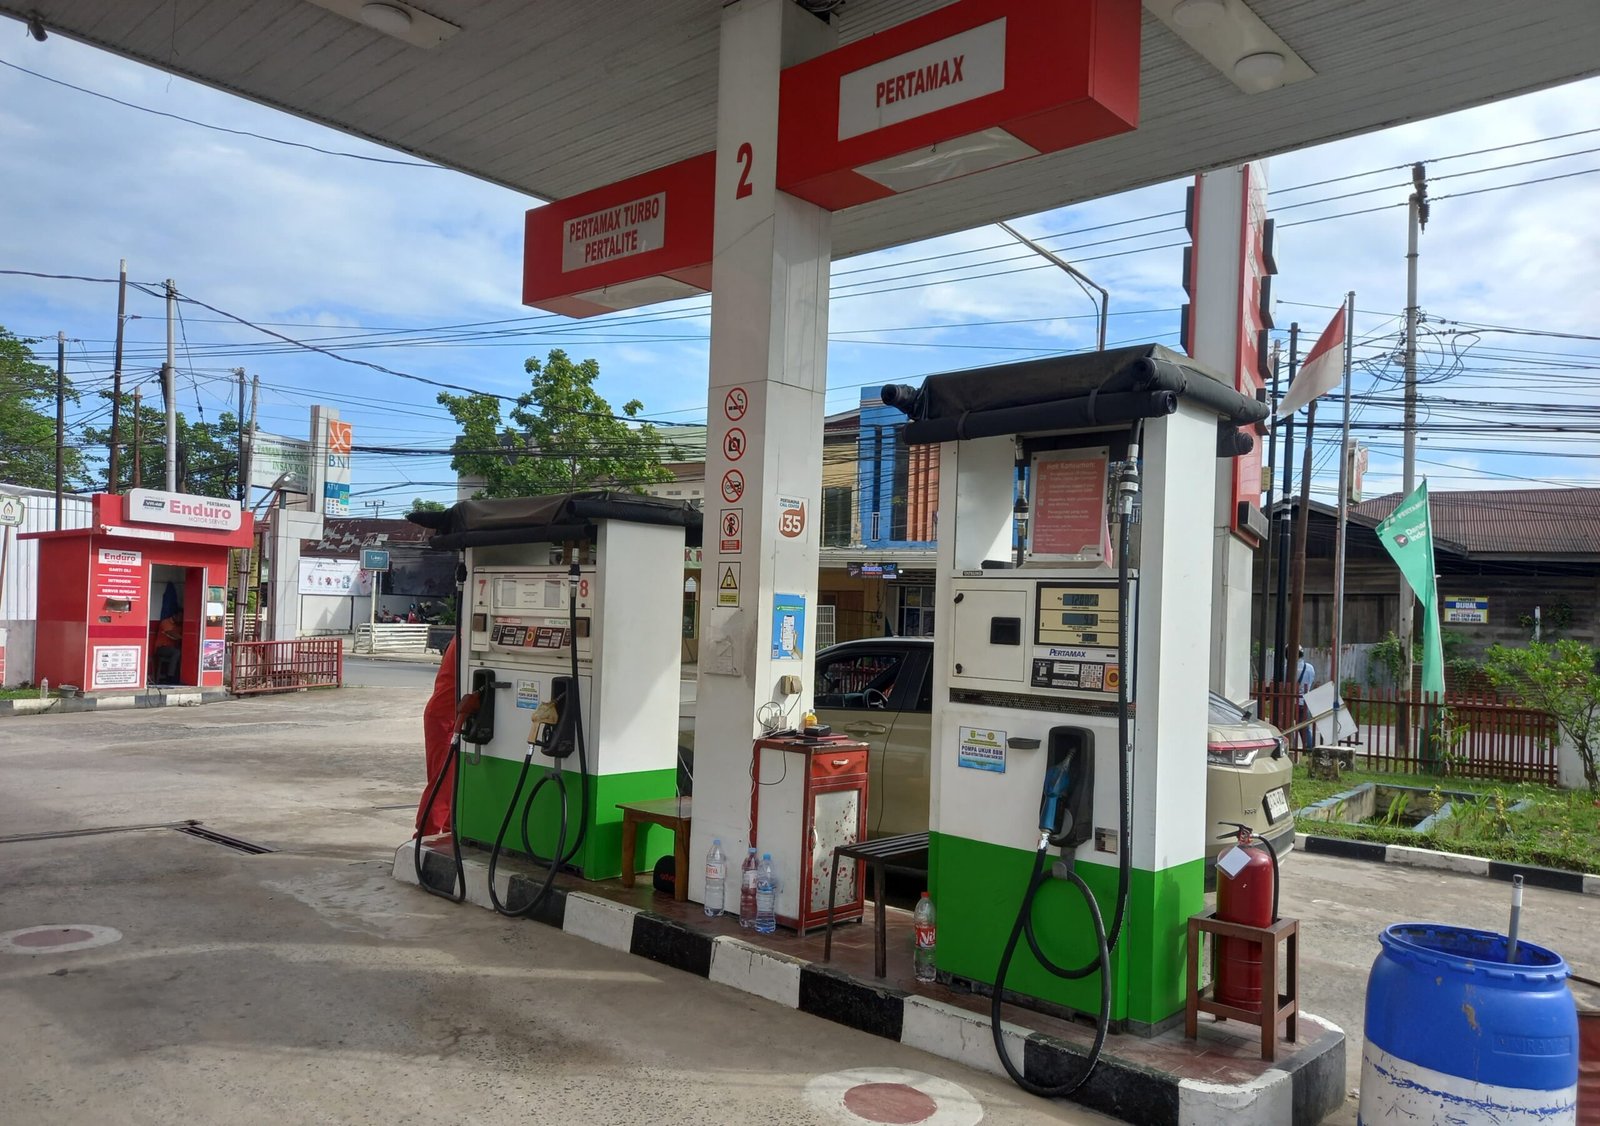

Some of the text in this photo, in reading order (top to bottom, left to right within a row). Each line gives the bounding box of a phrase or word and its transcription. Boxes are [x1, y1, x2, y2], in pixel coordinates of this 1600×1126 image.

[876, 55, 965, 108] PERTAMAX
[736, 142, 753, 200] 2
[569, 197, 660, 243] PERTAMAX TURBO
[584, 229, 638, 263] PERTALITE
[328, 454, 351, 469] BNI
[169, 499, 232, 520] Enduro
[188, 516, 229, 526] MOTOR SERVICE
[780, 513, 801, 533] 135
[104, 552, 136, 562] Enduro
[478, 579, 487, 597] 7
[579, 579, 589, 598] 8
[1049, 648, 1087, 658] PERTAMAX
